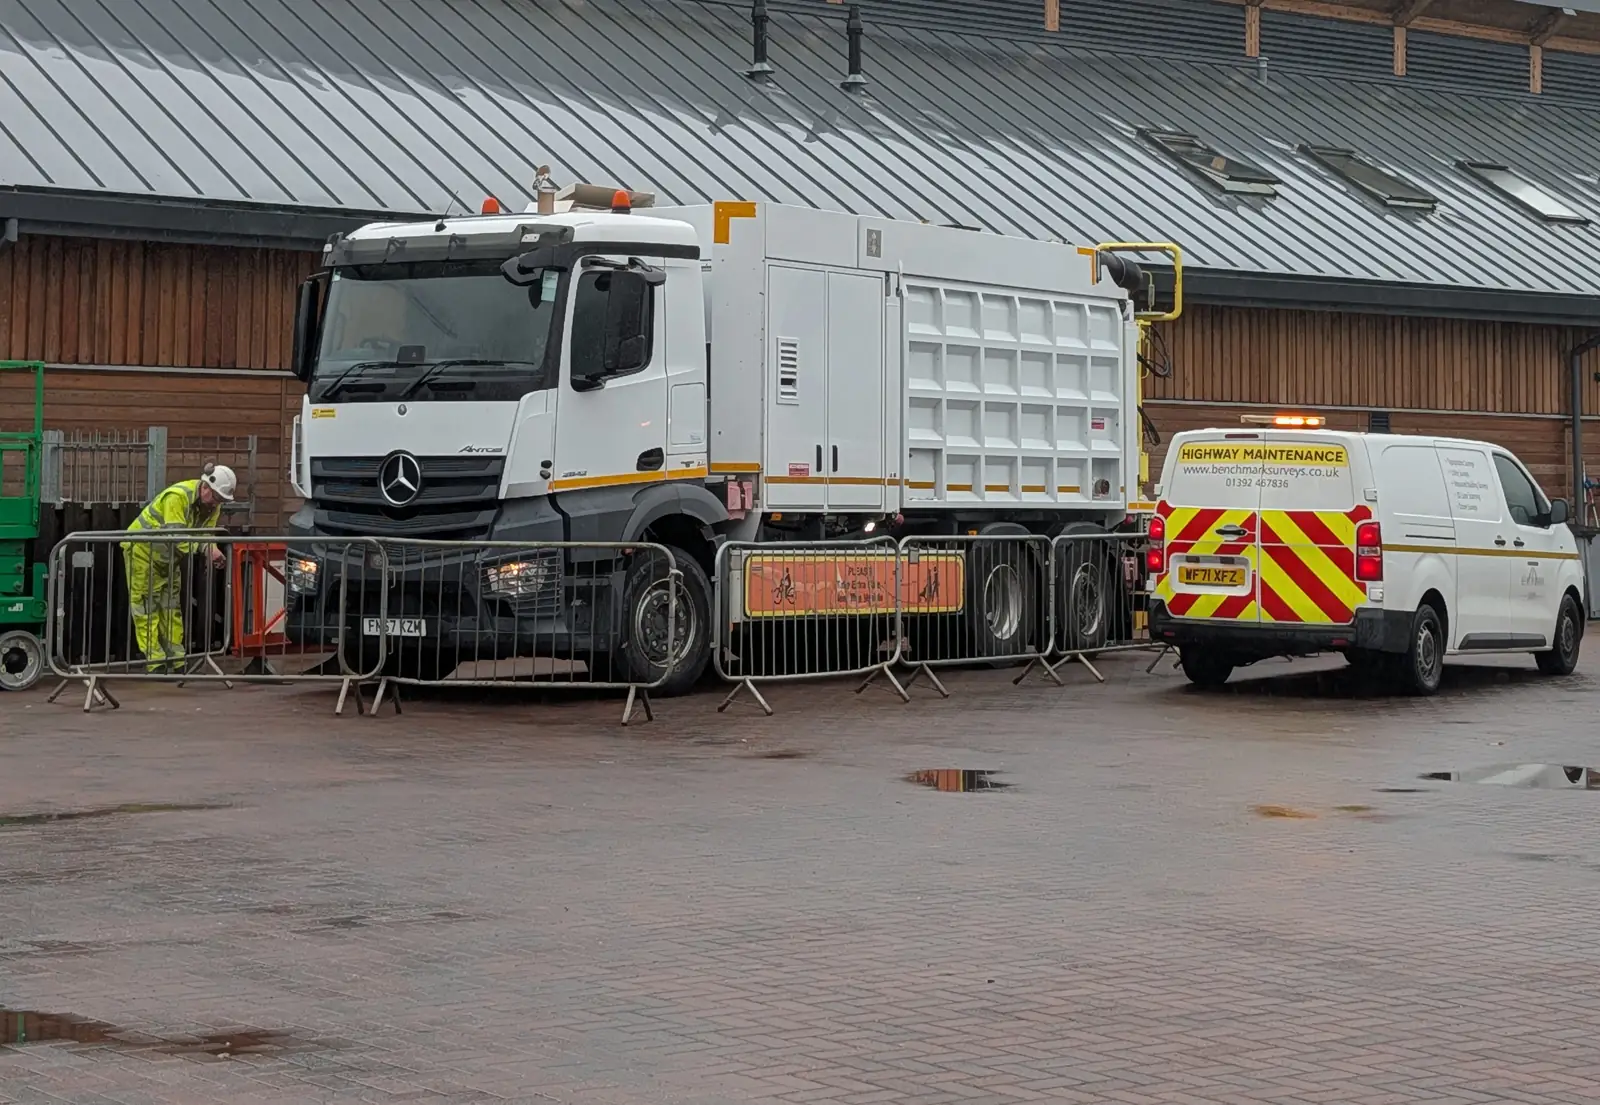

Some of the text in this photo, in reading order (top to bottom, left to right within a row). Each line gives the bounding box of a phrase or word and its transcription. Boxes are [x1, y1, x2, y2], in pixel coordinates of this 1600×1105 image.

[1182, 448, 1343, 462] HIGHWAY MAINTENANCE
[1183, 464, 1339, 478] www.benchmarksurveys.co.uk
[1225, 479, 1252, 488] 01392
[1214, 569, 1237, 583] XFZ
